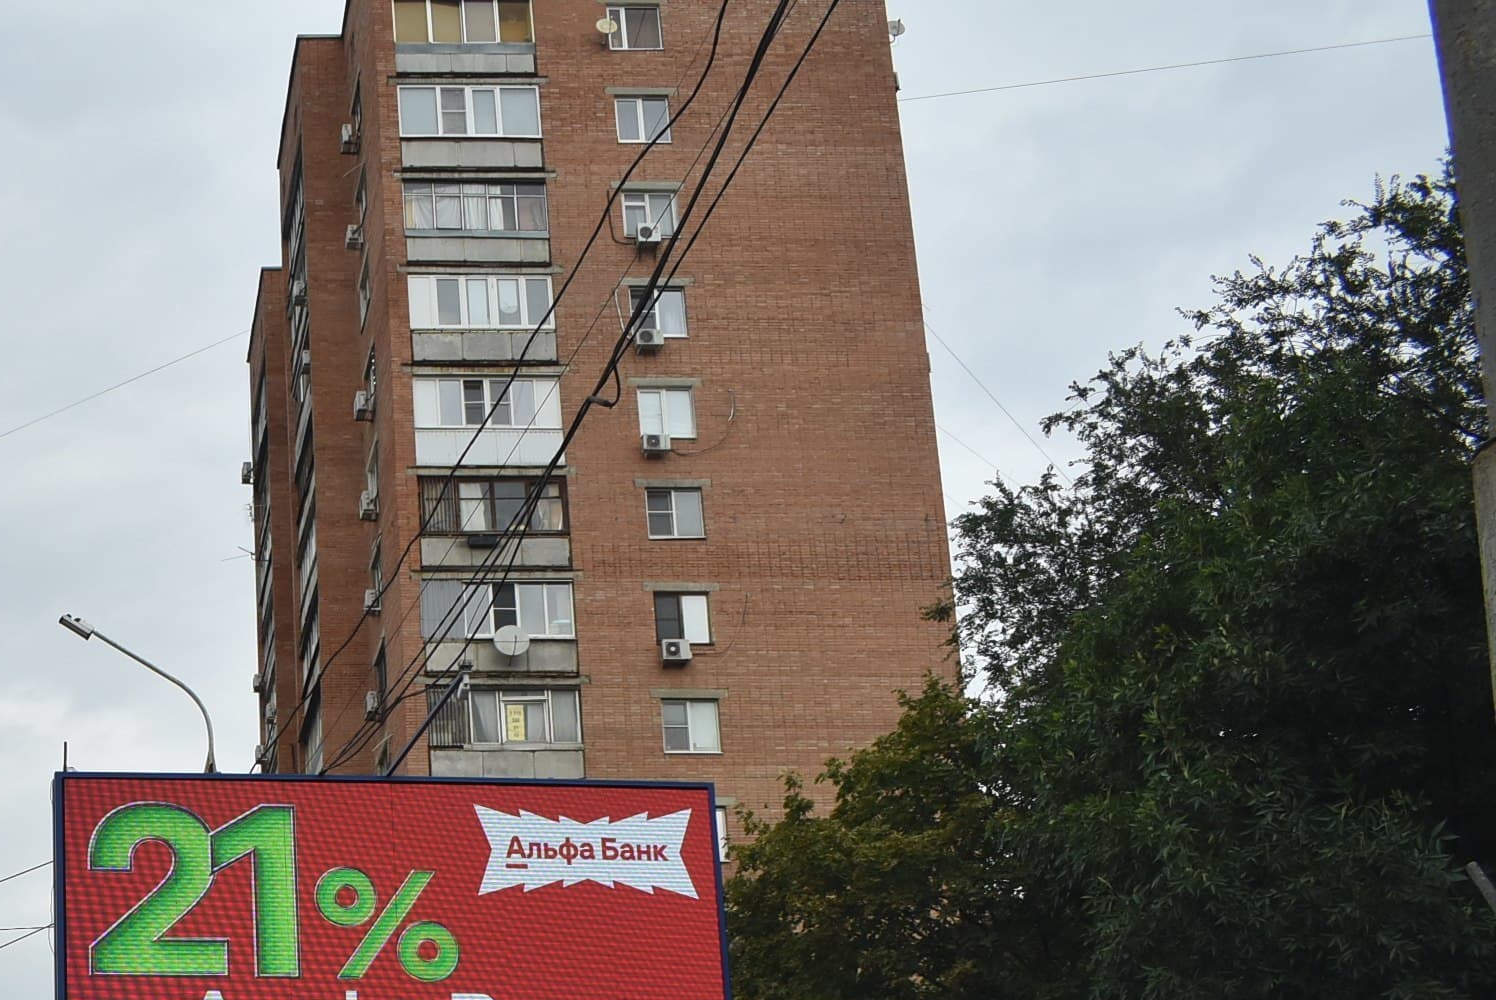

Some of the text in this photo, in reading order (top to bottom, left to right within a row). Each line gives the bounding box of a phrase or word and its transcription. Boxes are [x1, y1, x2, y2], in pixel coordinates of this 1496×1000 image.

[88, 800, 459, 982] 21%
[505, 835, 669, 869] Альфа Банк
